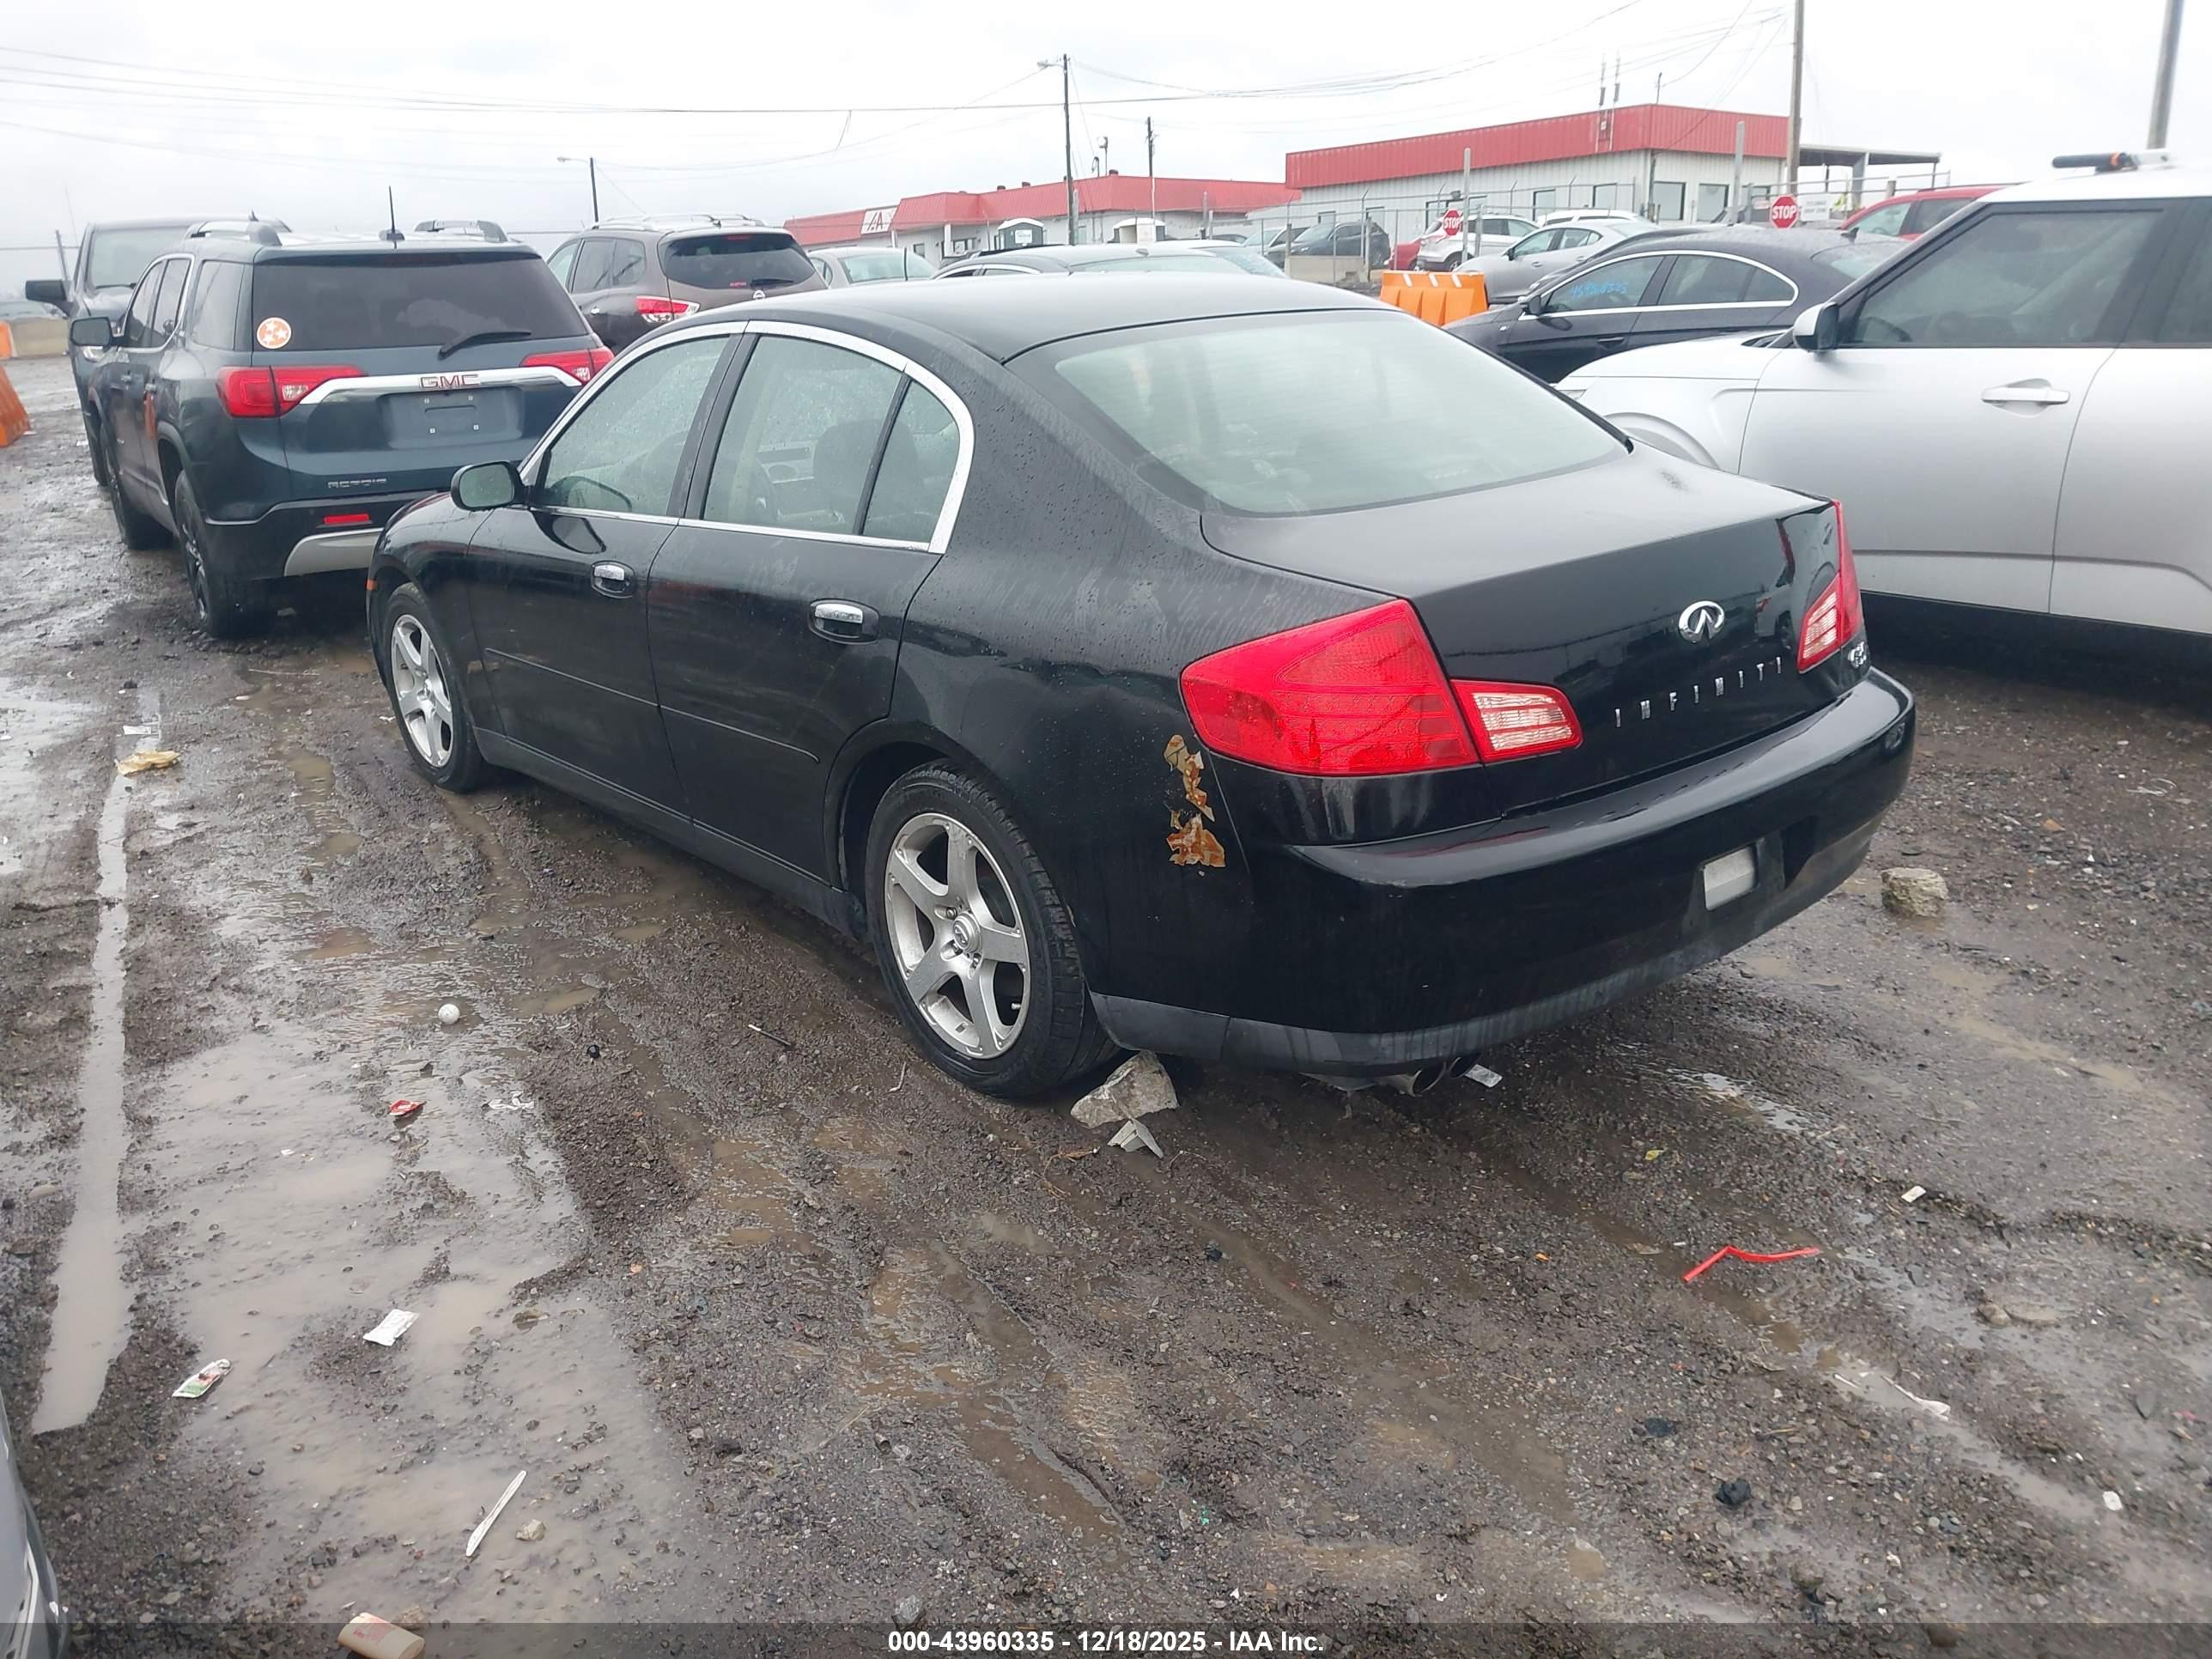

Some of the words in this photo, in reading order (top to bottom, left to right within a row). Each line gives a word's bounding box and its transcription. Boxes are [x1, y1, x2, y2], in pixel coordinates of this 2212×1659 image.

[1771, 205, 1796, 220] STOP
[1443, 216, 1461, 229] STOP
[420, 374, 479, 390] GMC
[1614, 656, 1782, 728] INFINITI
